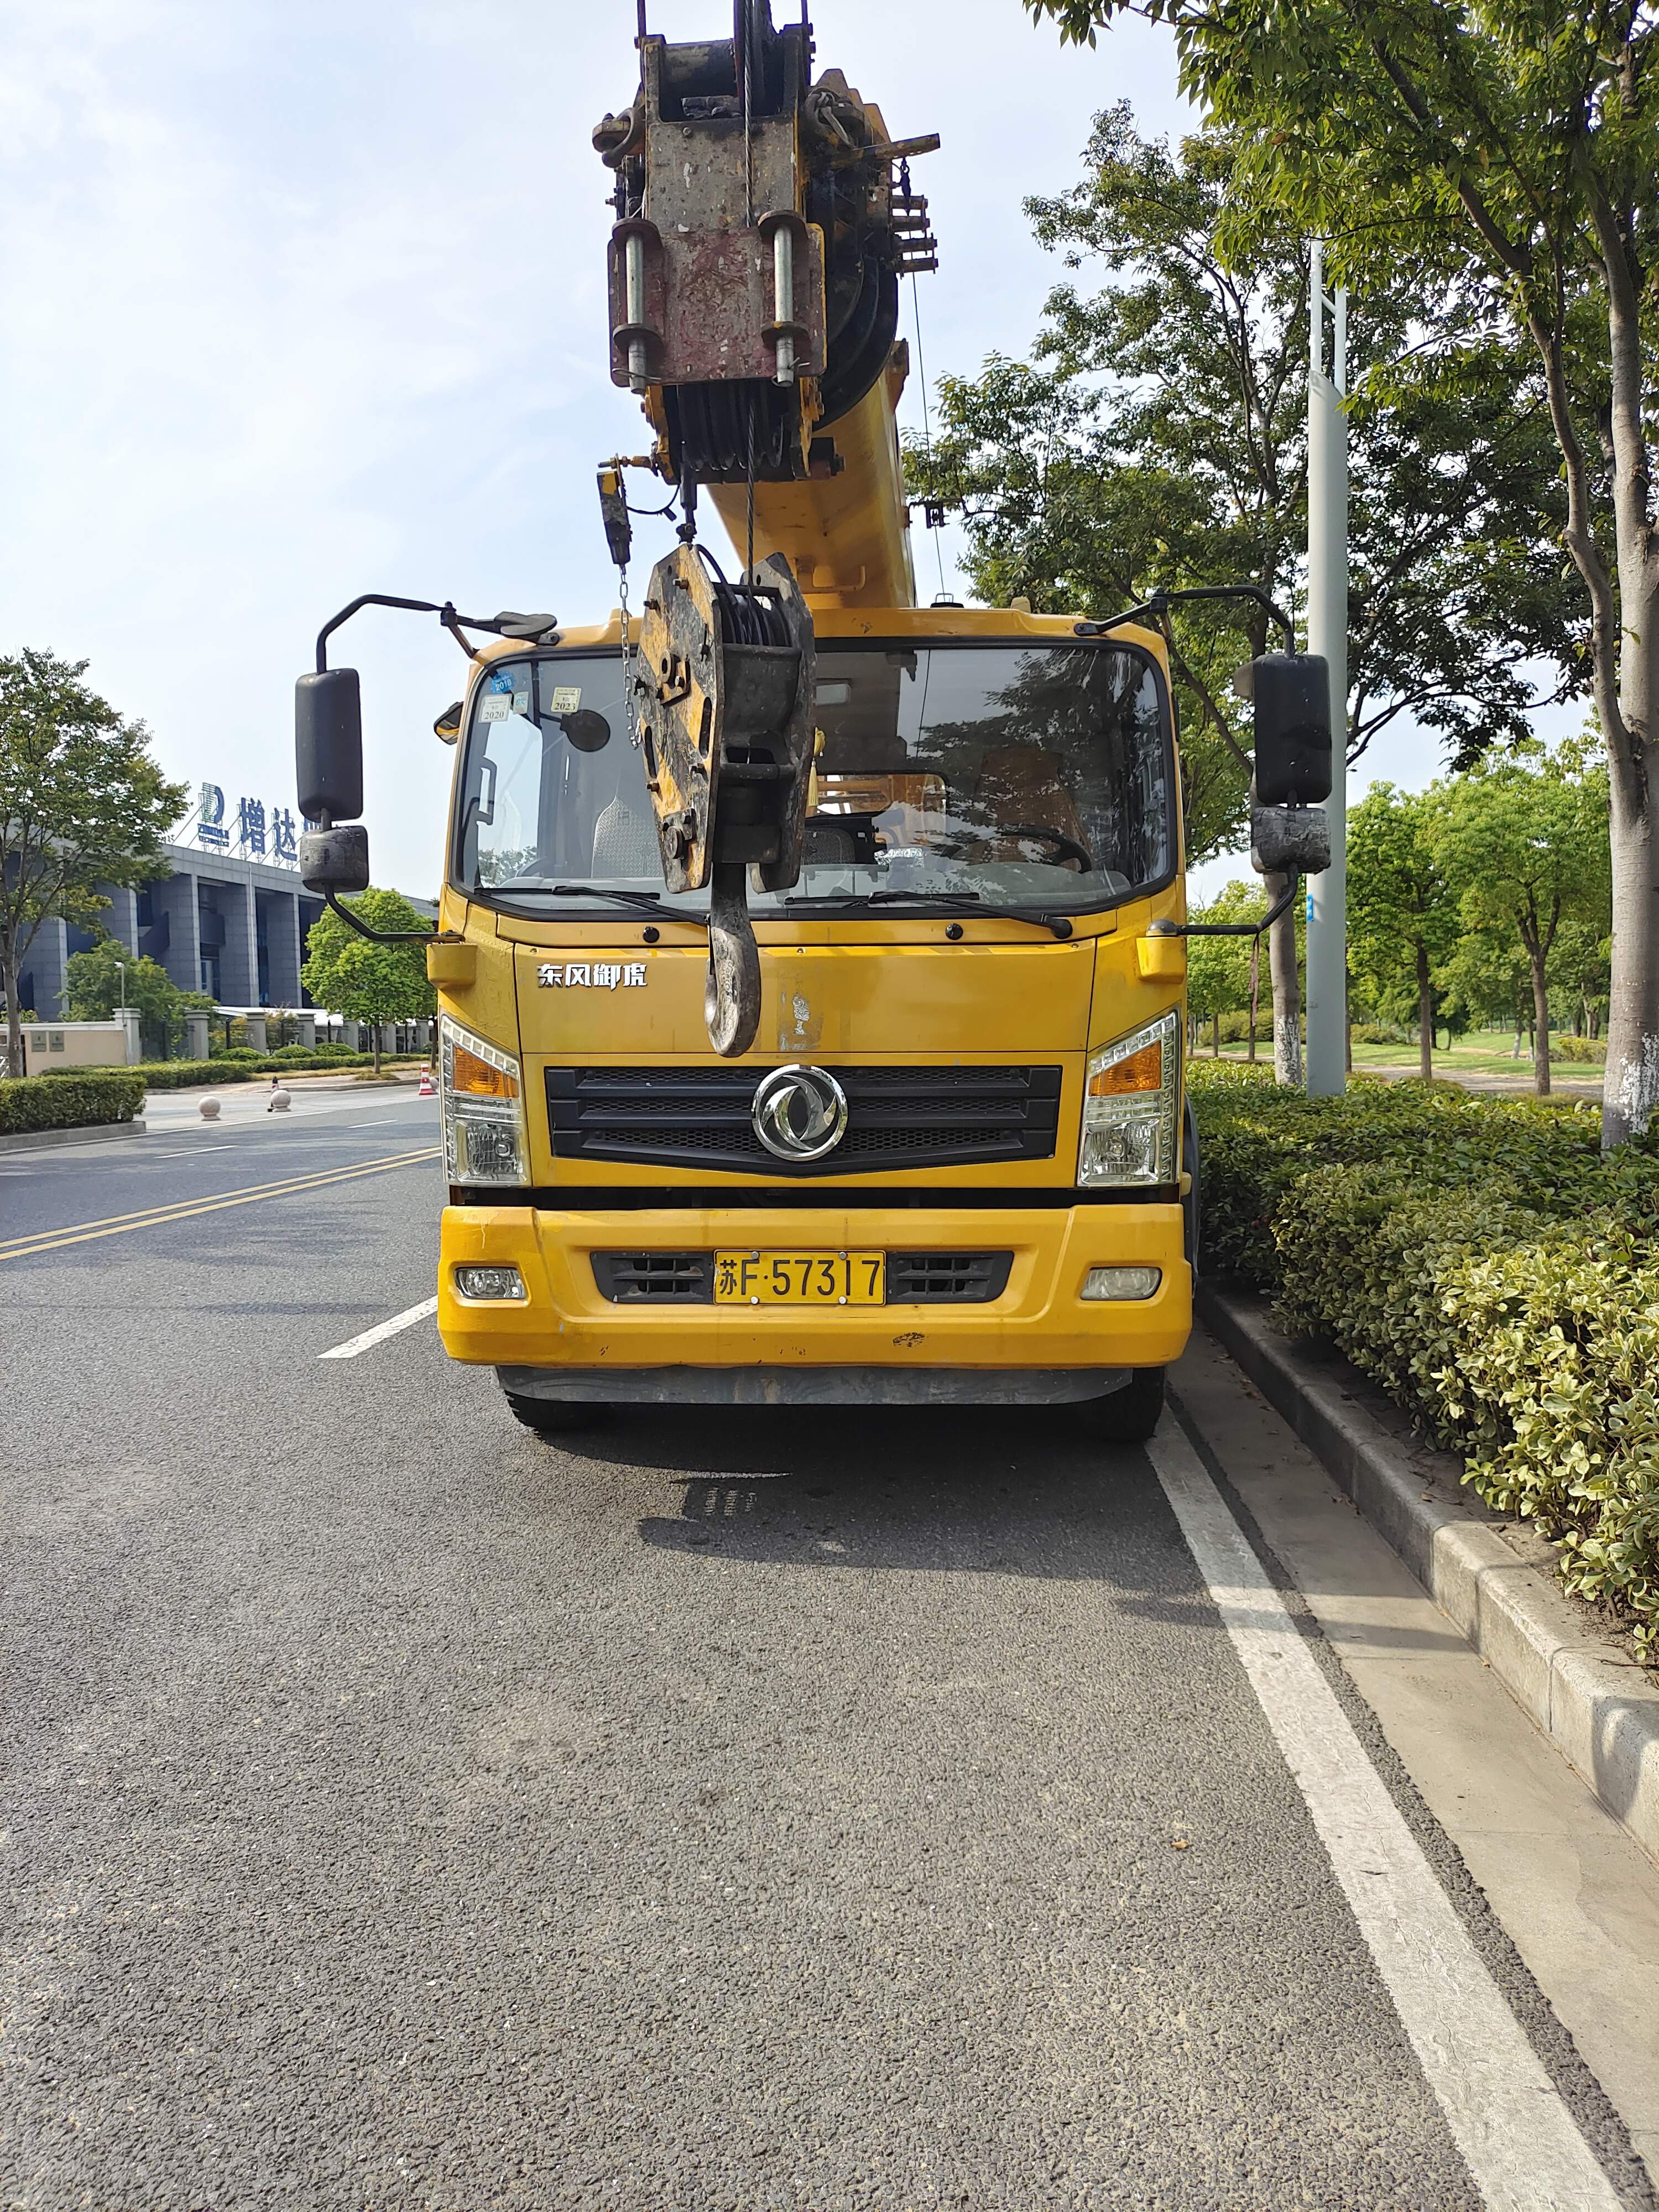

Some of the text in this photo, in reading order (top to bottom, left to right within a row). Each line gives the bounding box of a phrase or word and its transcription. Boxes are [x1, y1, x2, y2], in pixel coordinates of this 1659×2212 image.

[484, 711, 504, 719] 2020
[554, 702, 576, 711] 2023
[240, 797, 324, 861] 增达
[536, 963, 648, 992] 东风御虎
